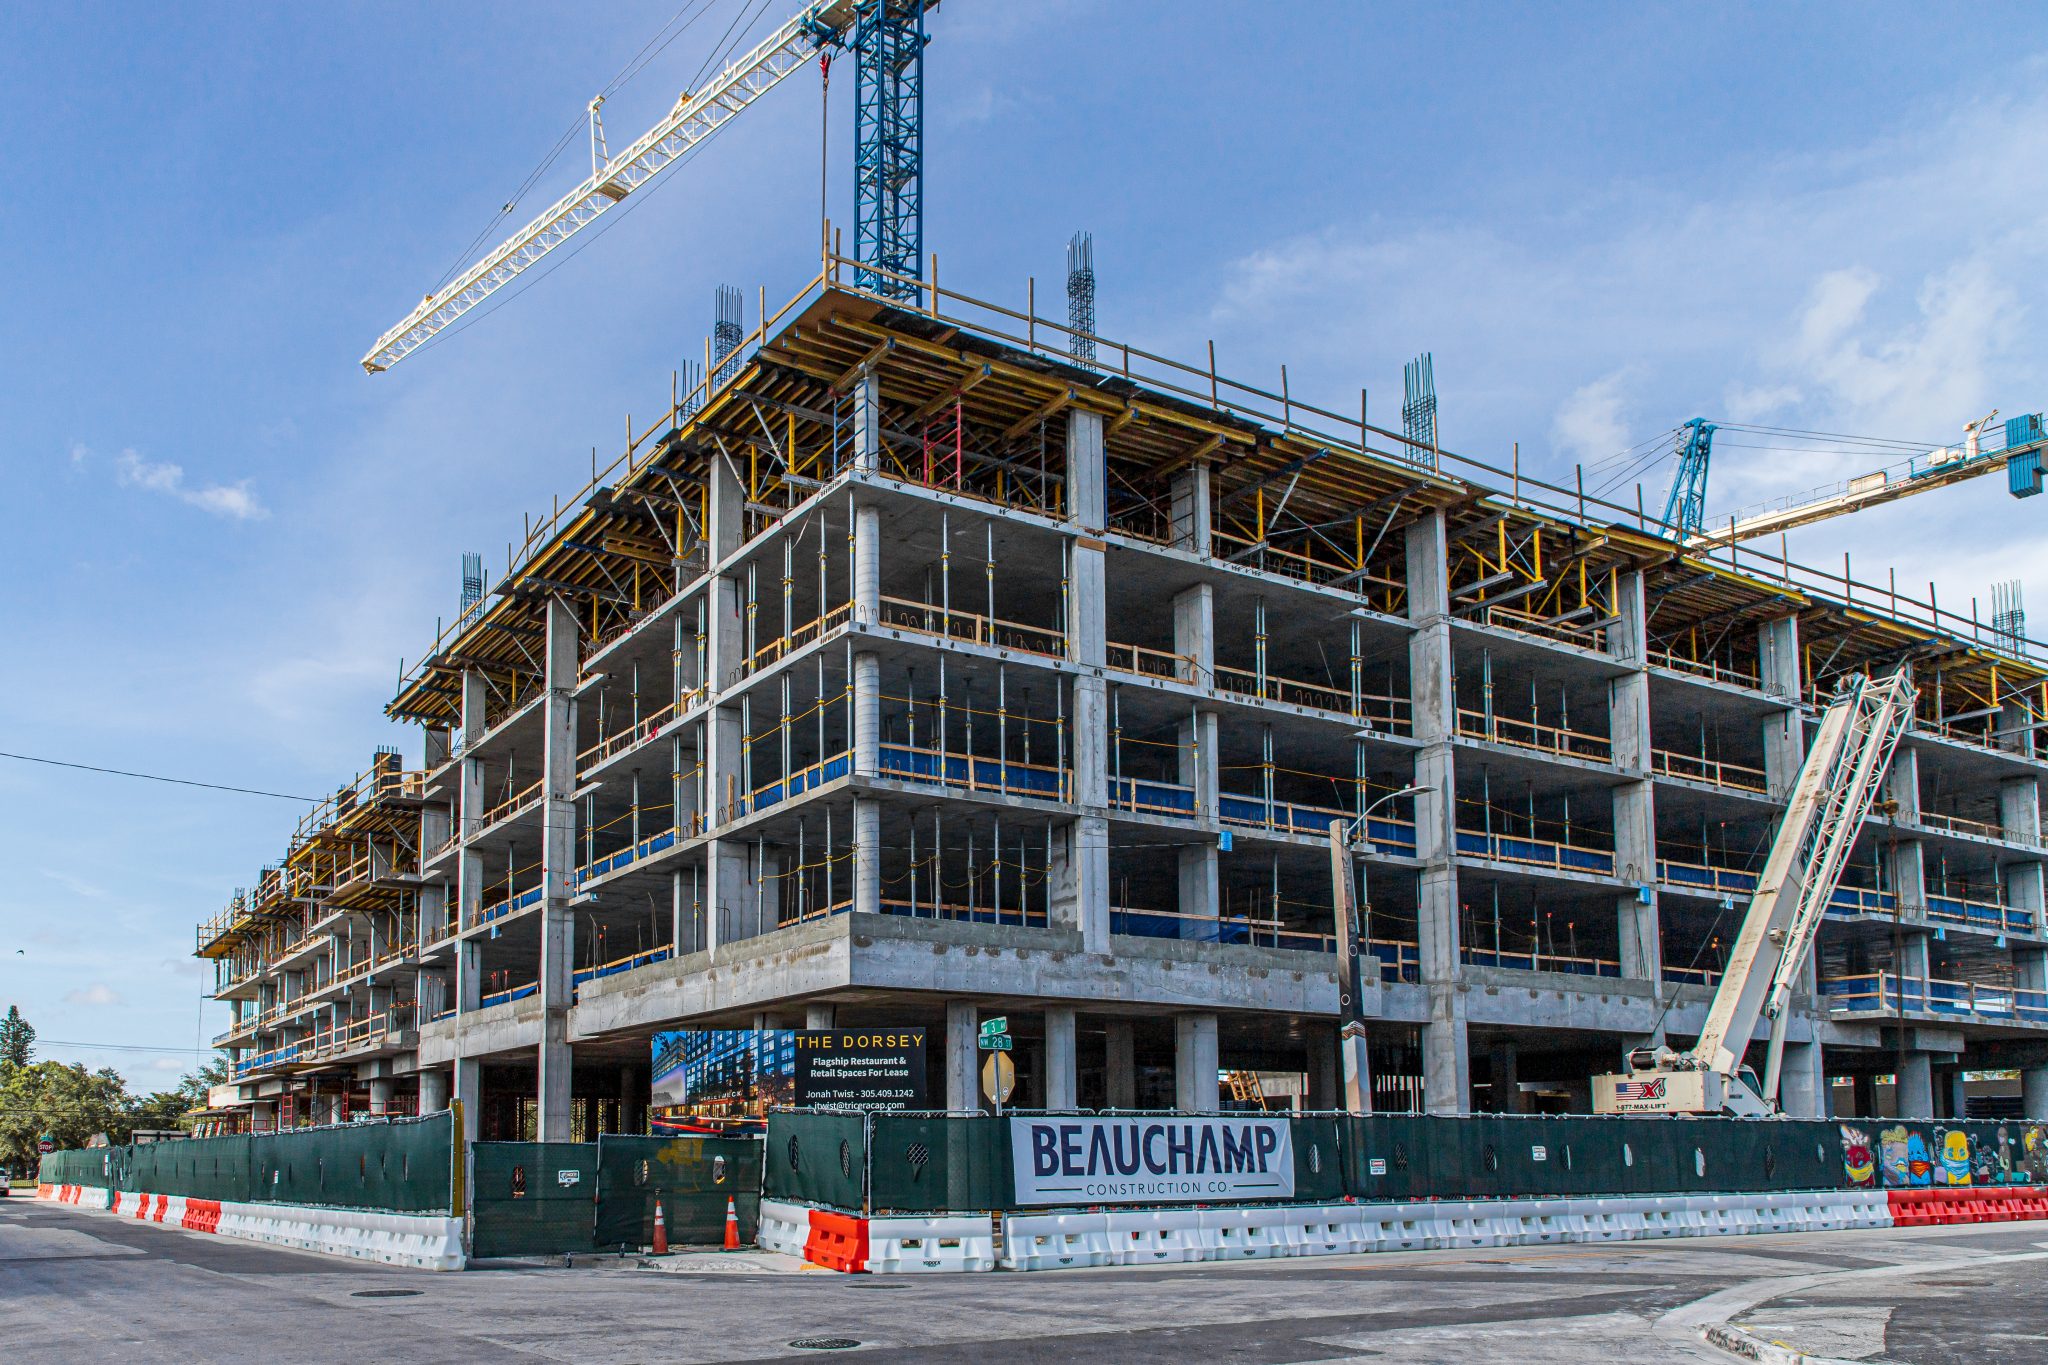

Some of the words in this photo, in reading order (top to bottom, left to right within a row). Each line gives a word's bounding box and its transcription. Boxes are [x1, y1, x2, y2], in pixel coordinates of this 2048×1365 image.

[991, 1021, 996, 1033] 3
[796, 1036, 833, 1049] THE
[843, 1035, 923, 1048] DORSEY
[980, 1038, 989, 1047] NW
[992, 1036, 1003, 1048] 28
[813, 1057, 849, 1067] Flagship
[851, 1057, 898, 1066] Restaurant
[899, 1057, 907, 1065] &
[810, 1069, 836, 1078] Retail
[837, 1069, 867, 1079] Spaces
[868, 1069, 883, 1077] For
[884, 1068, 909, 1077] Lease
[805, 1090, 831, 1099] Jonah
[832, 1090, 855, 1098] Twist
[861, 1089, 914, 1098] 305.409.1242
[1032, 1125, 1277, 1176] BEAUCHAMP
[1086, 1182, 1201, 1196] CONSTRUCTION
[1208, 1181, 1231, 1193] CO.
